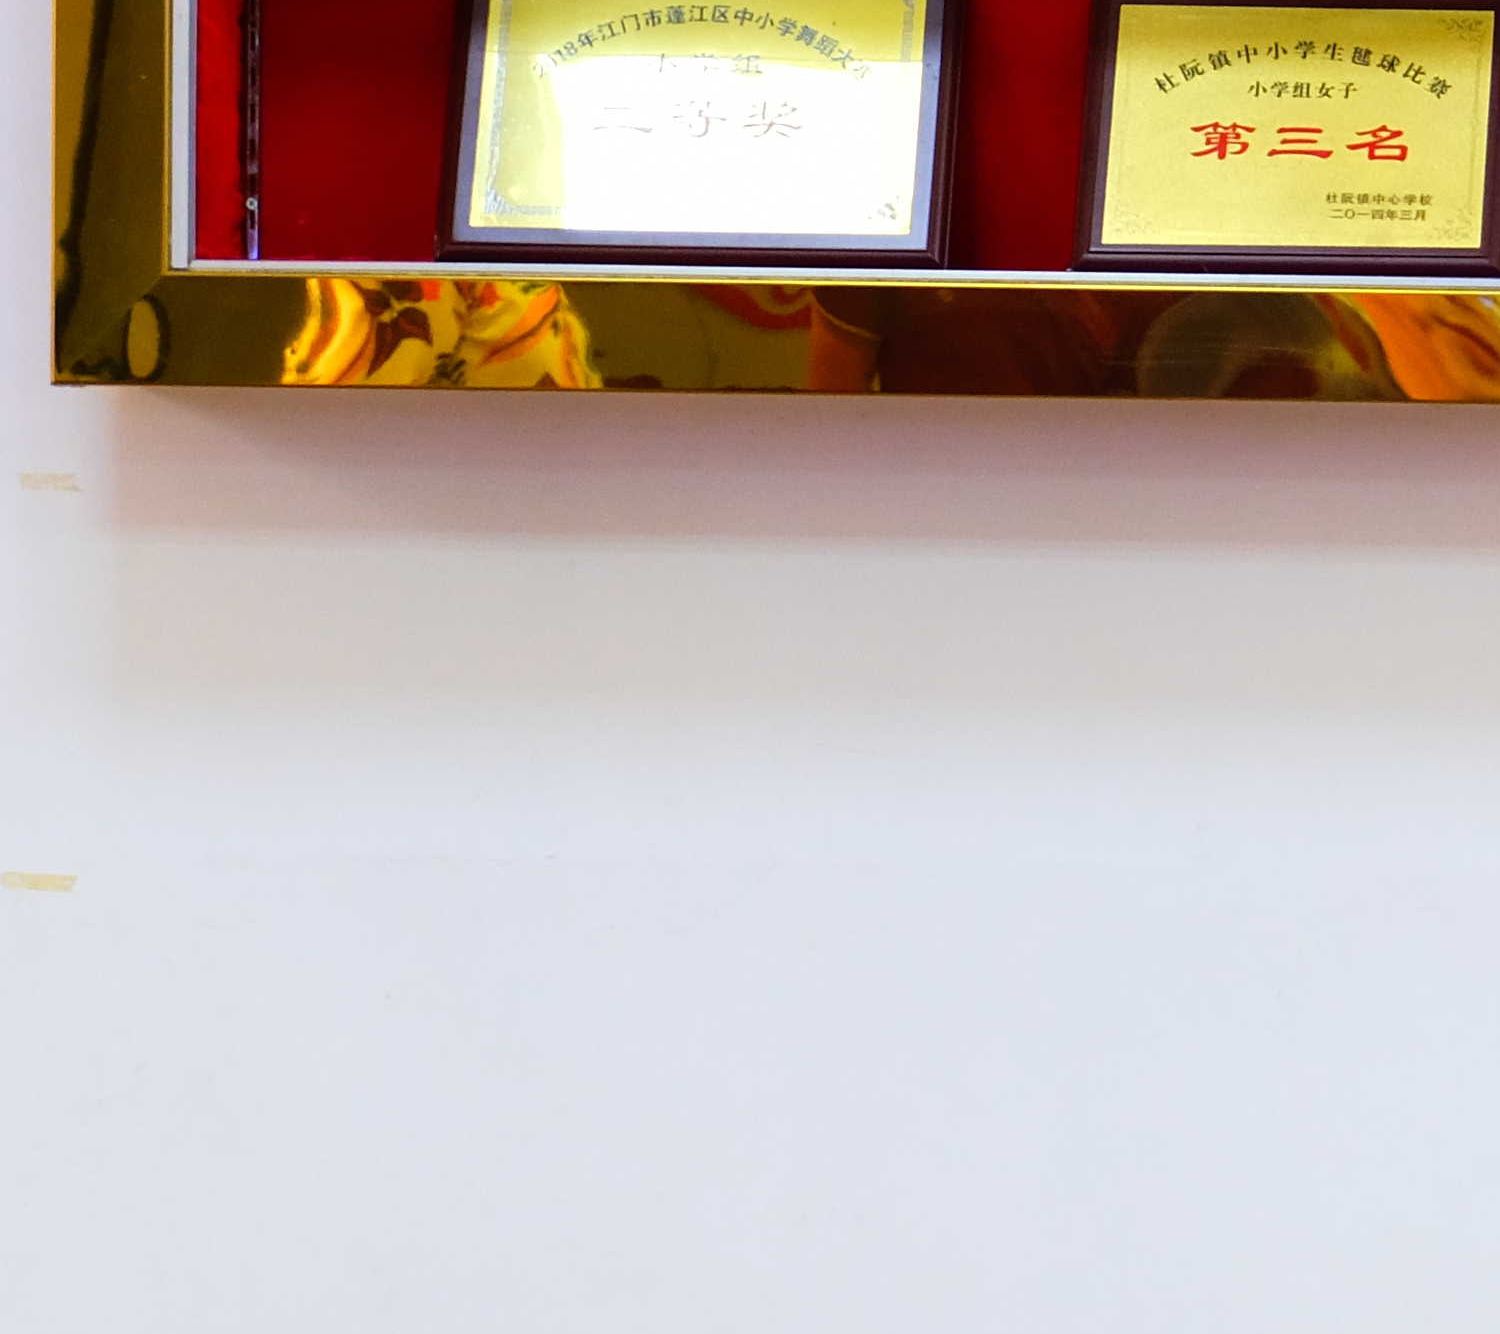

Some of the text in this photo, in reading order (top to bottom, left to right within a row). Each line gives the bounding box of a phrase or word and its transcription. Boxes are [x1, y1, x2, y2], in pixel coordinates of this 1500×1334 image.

[1153, 39, 1453, 101] 杜阮镇中小学生毽球比赛
[1247, 82, 1358, 100] 小学组女子
[593, 101, 802, 138] 二等奖
[1190, 121, 1408, 162] 第三名
[1325, 192, 1432, 207] 杜阮镇中心学校
